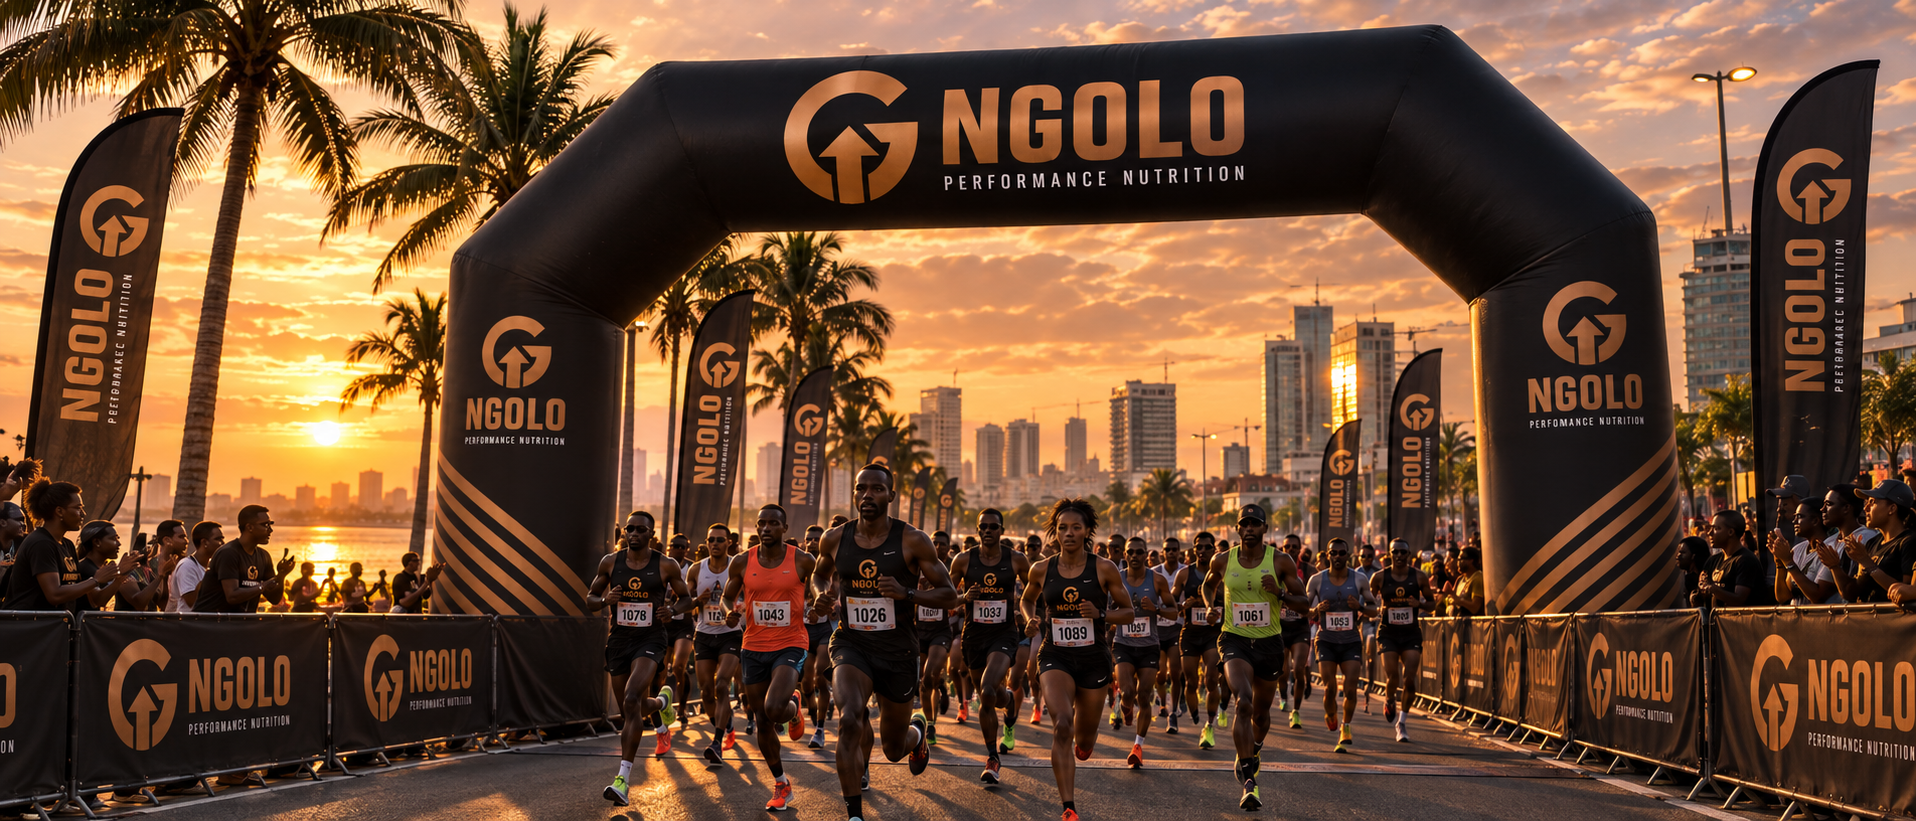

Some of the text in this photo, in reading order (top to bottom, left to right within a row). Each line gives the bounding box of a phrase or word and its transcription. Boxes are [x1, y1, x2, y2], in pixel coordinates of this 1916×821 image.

[942, 75, 1245, 166] NGOLO
[943, 165, 1246, 191] PERFORMANCE NUTRITION
[1785, 238, 1825, 392] NGOLO
[60, 268, 114, 423] NGOLO
[1527, 373, 1643, 413] NGOLO
[465, 397, 566, 431] NGOLO
[1600, 416, 1645, 425] NUTRITION
[520, 437, 566, 446] NUTRITION
[693, 394, 722, 485] NGOLO
[790, 441, 811, 505] NGOLO
[1401, 436, 1422, 508] NGOLO
[1328, 479, 1344, 528] NGOLO
[622, 609, 647, 621] 1078
[758, 609, 784, 621] 1043
[853, 607, 887, 623] 1026
[1058, 626, 1087, 640] 1089
[1238, 610, 1264, 621] 1061
[188, 655, 291, 714] NGOLO
[409, 648, 472, 693] NGOLO
[1615, 650, 1674, 703] NGOLO
[1807, 658, 1916, 733] NGOLO
[188, 715, 290, 736] PERFORMANCE NUTRITION
[1807, 731, 1916, 762] PERFORMANCE NUTRITION
